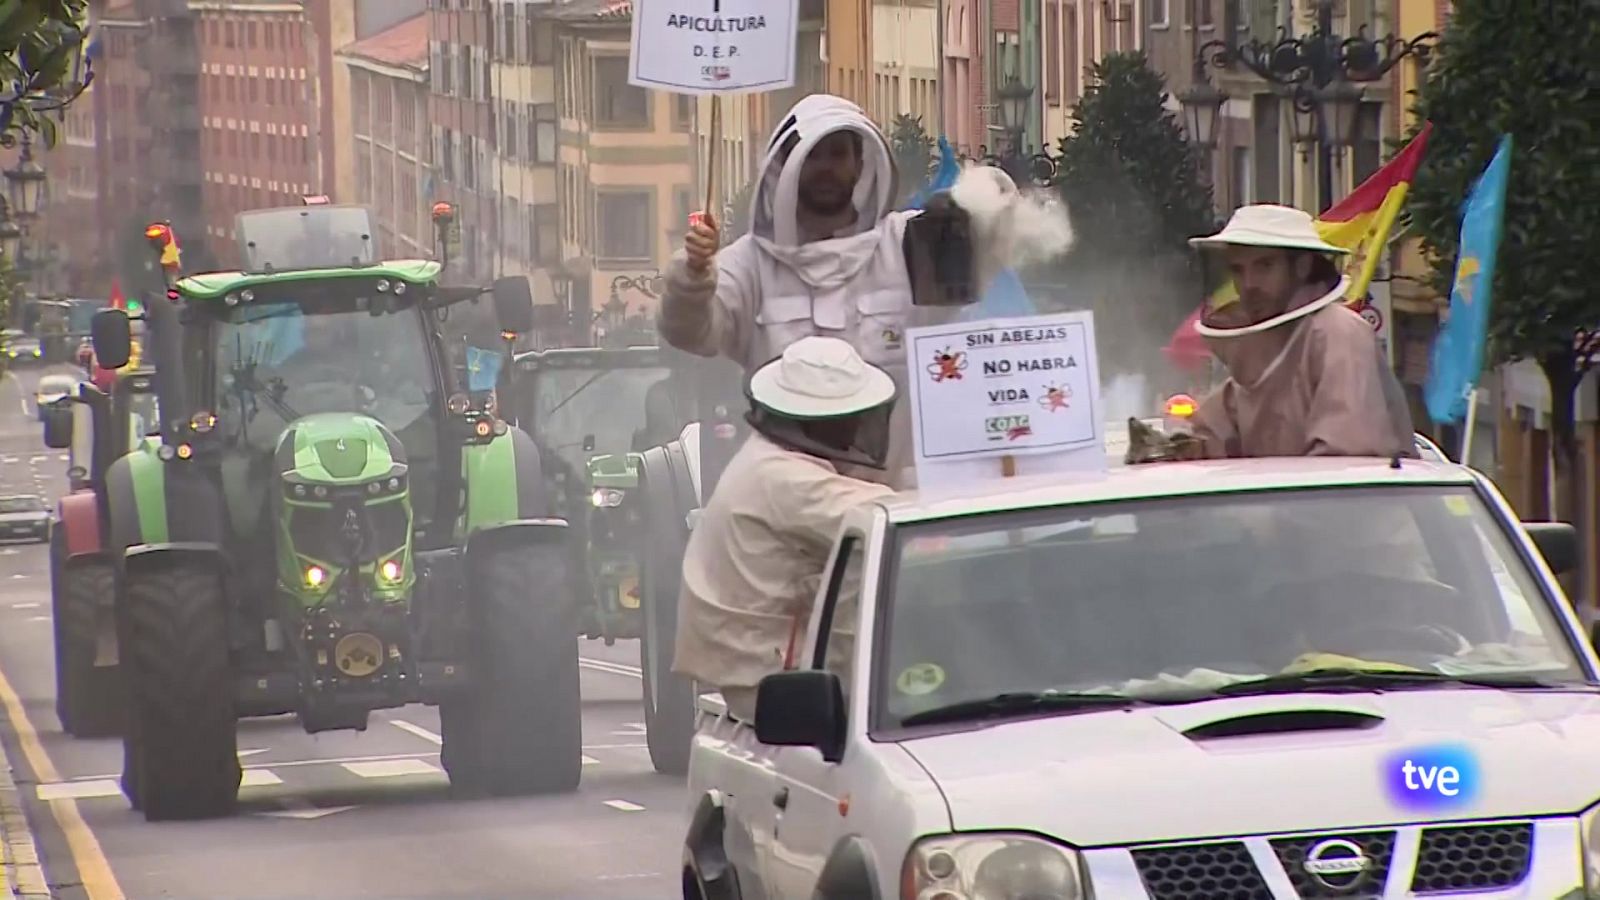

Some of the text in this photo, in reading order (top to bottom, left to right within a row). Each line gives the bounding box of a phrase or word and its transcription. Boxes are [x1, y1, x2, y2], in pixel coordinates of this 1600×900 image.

[667, 14, 766, 32] APICULTURA
[693, 45, 740, 59] D. E. P.
[966, 328, 1067, 347] SIN ABEJAS
[983, 356, 1077, 374] NO HABRA
[988, 389, 1030, 402] VIDA
